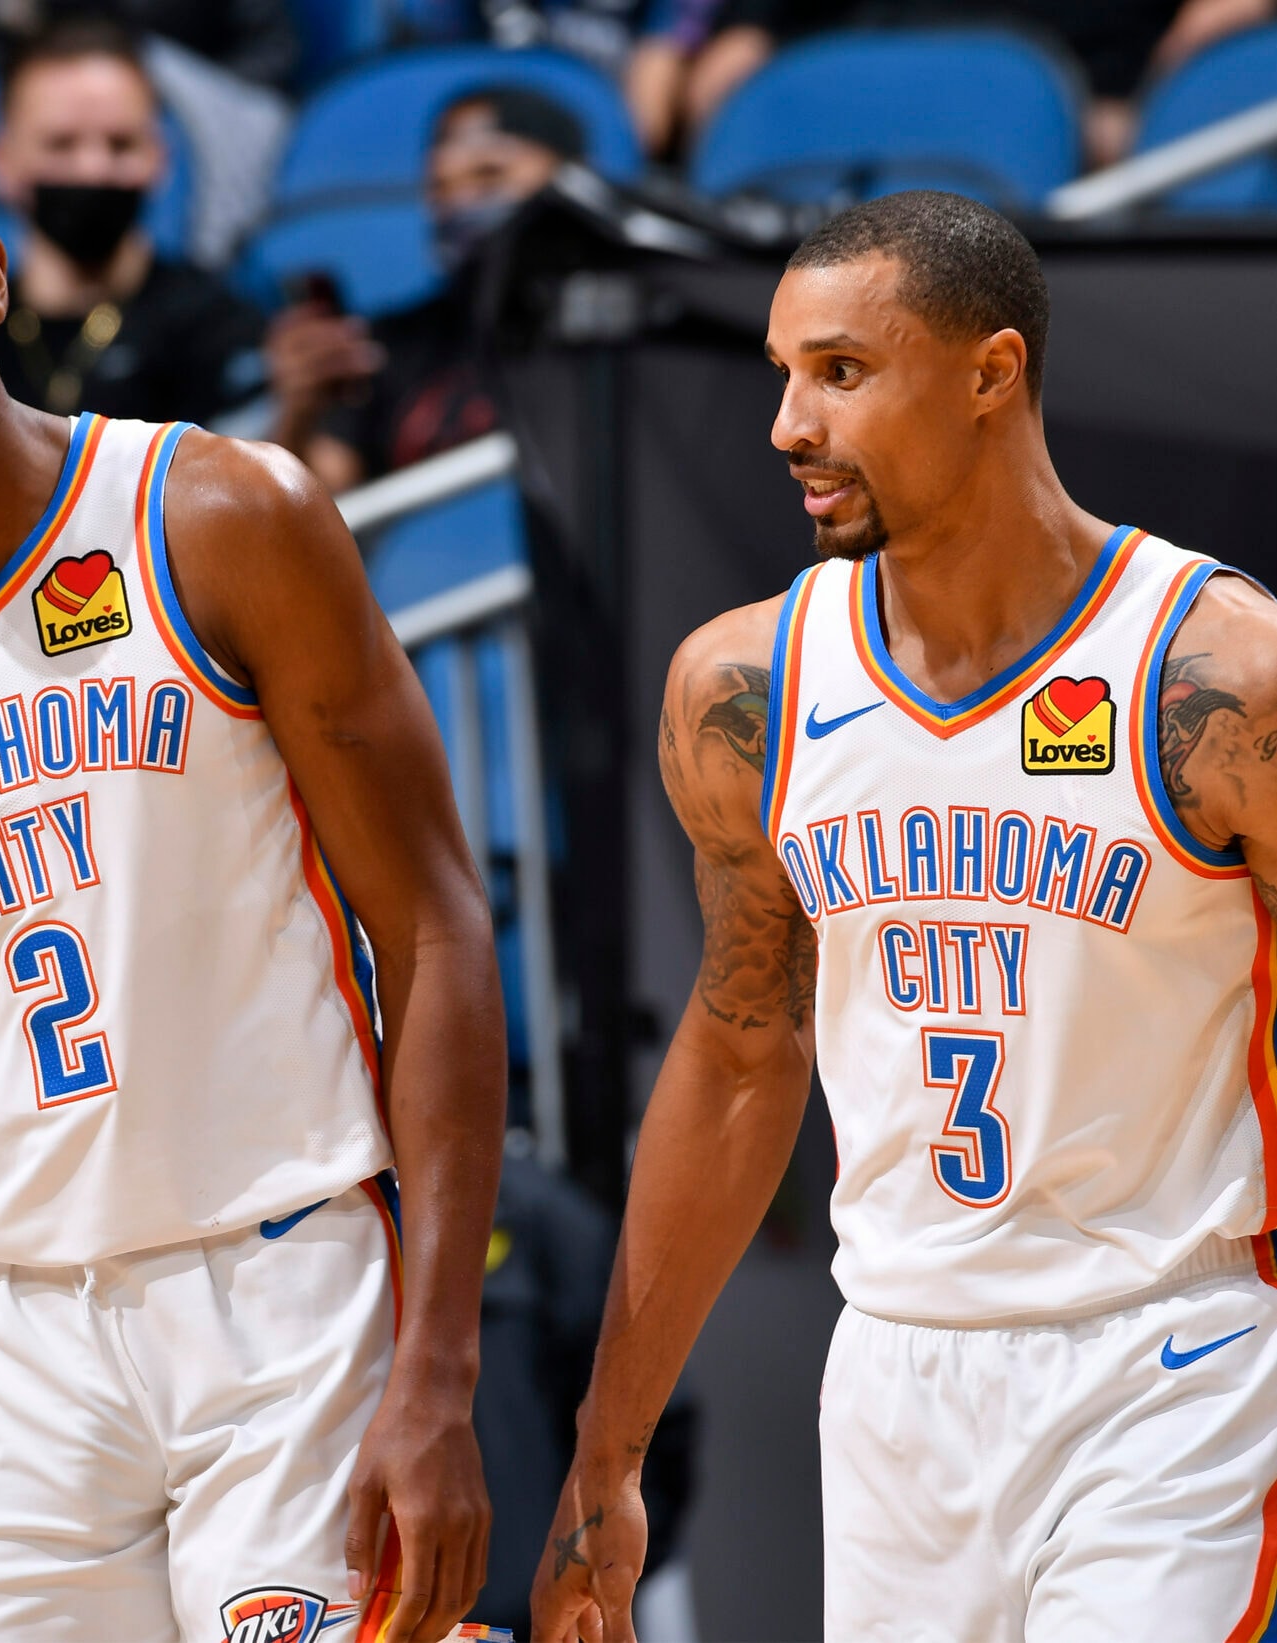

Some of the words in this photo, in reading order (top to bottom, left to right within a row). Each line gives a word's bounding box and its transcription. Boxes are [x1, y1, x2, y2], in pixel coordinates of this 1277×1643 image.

[776, 804, 1152, 935] OKLAHOMA
[5, 919, 119, 1111] 2
[878, 919, 1030, 1017] CITY
[920, 1026, 1013, 1209] 3
[228, 1602, 302, 1643] OKC
